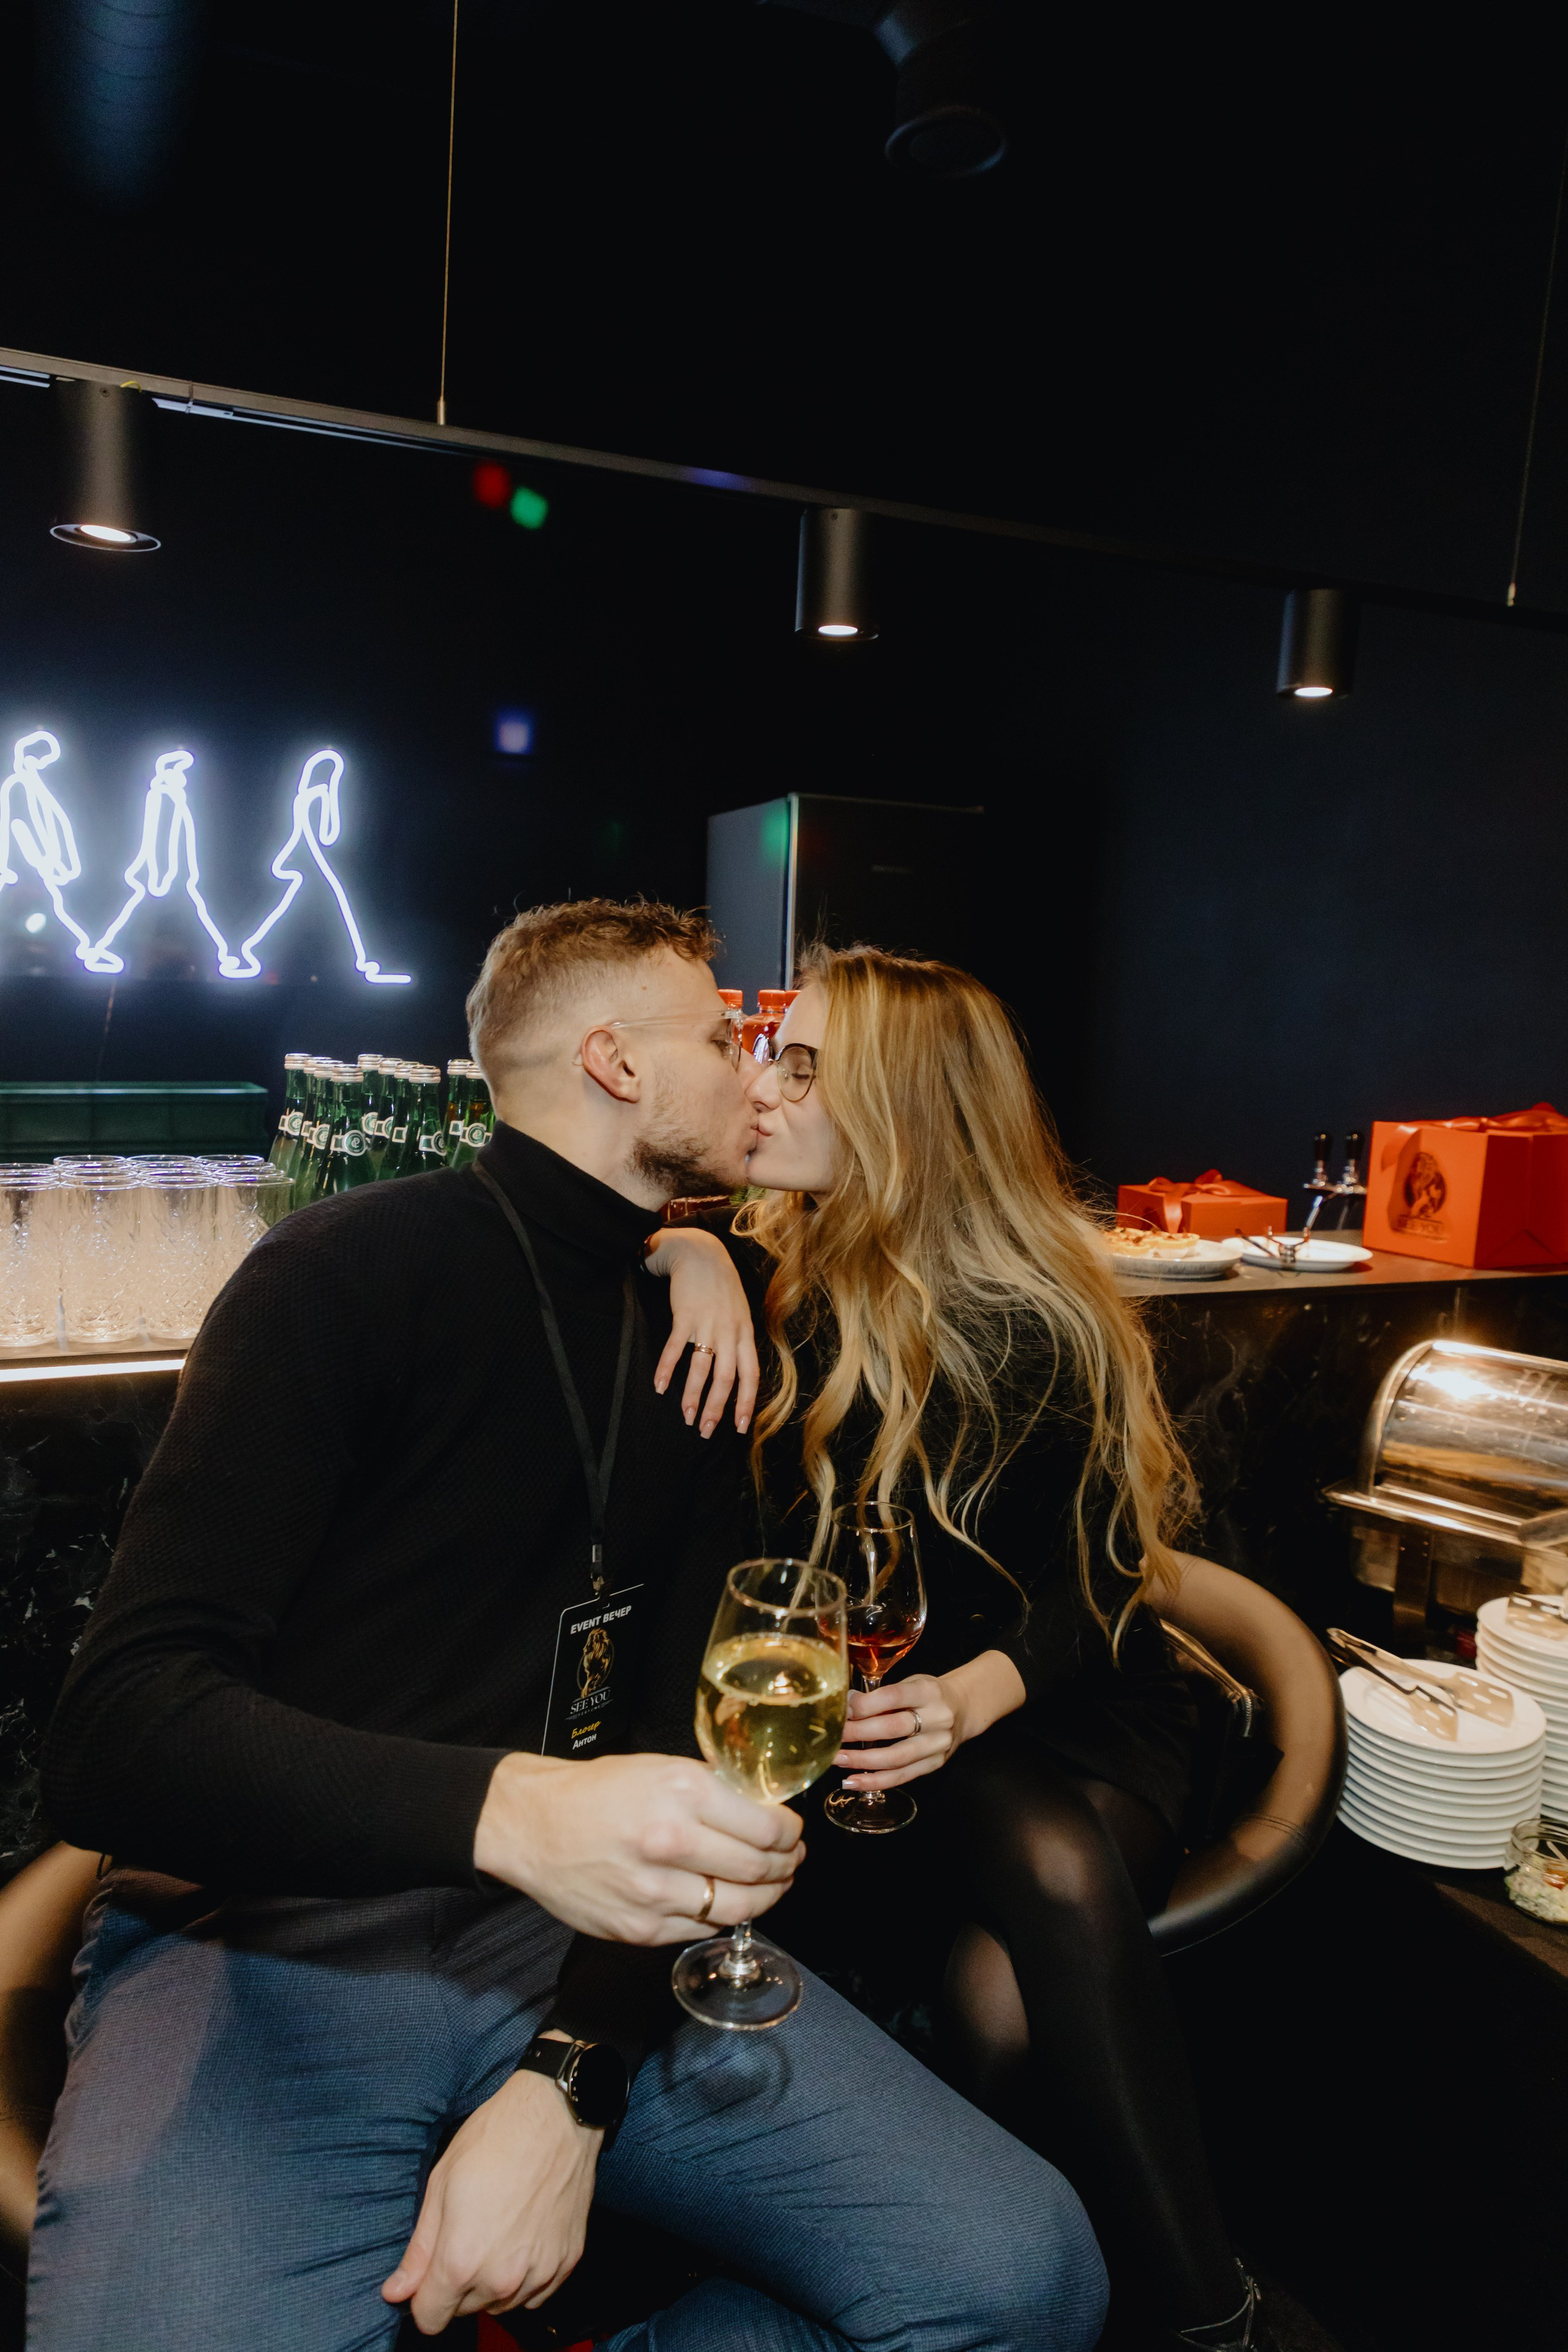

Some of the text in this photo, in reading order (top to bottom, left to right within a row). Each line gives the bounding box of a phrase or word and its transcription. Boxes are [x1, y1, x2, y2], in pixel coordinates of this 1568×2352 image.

[570, 1605, 632, 1635] EVENT ВЕЧЕР
[570, 1689, 611, 1714] SEE YOU
[571, 1721, 601, 1739] Блогер
[572, 1733, 597, 1750] Антон
